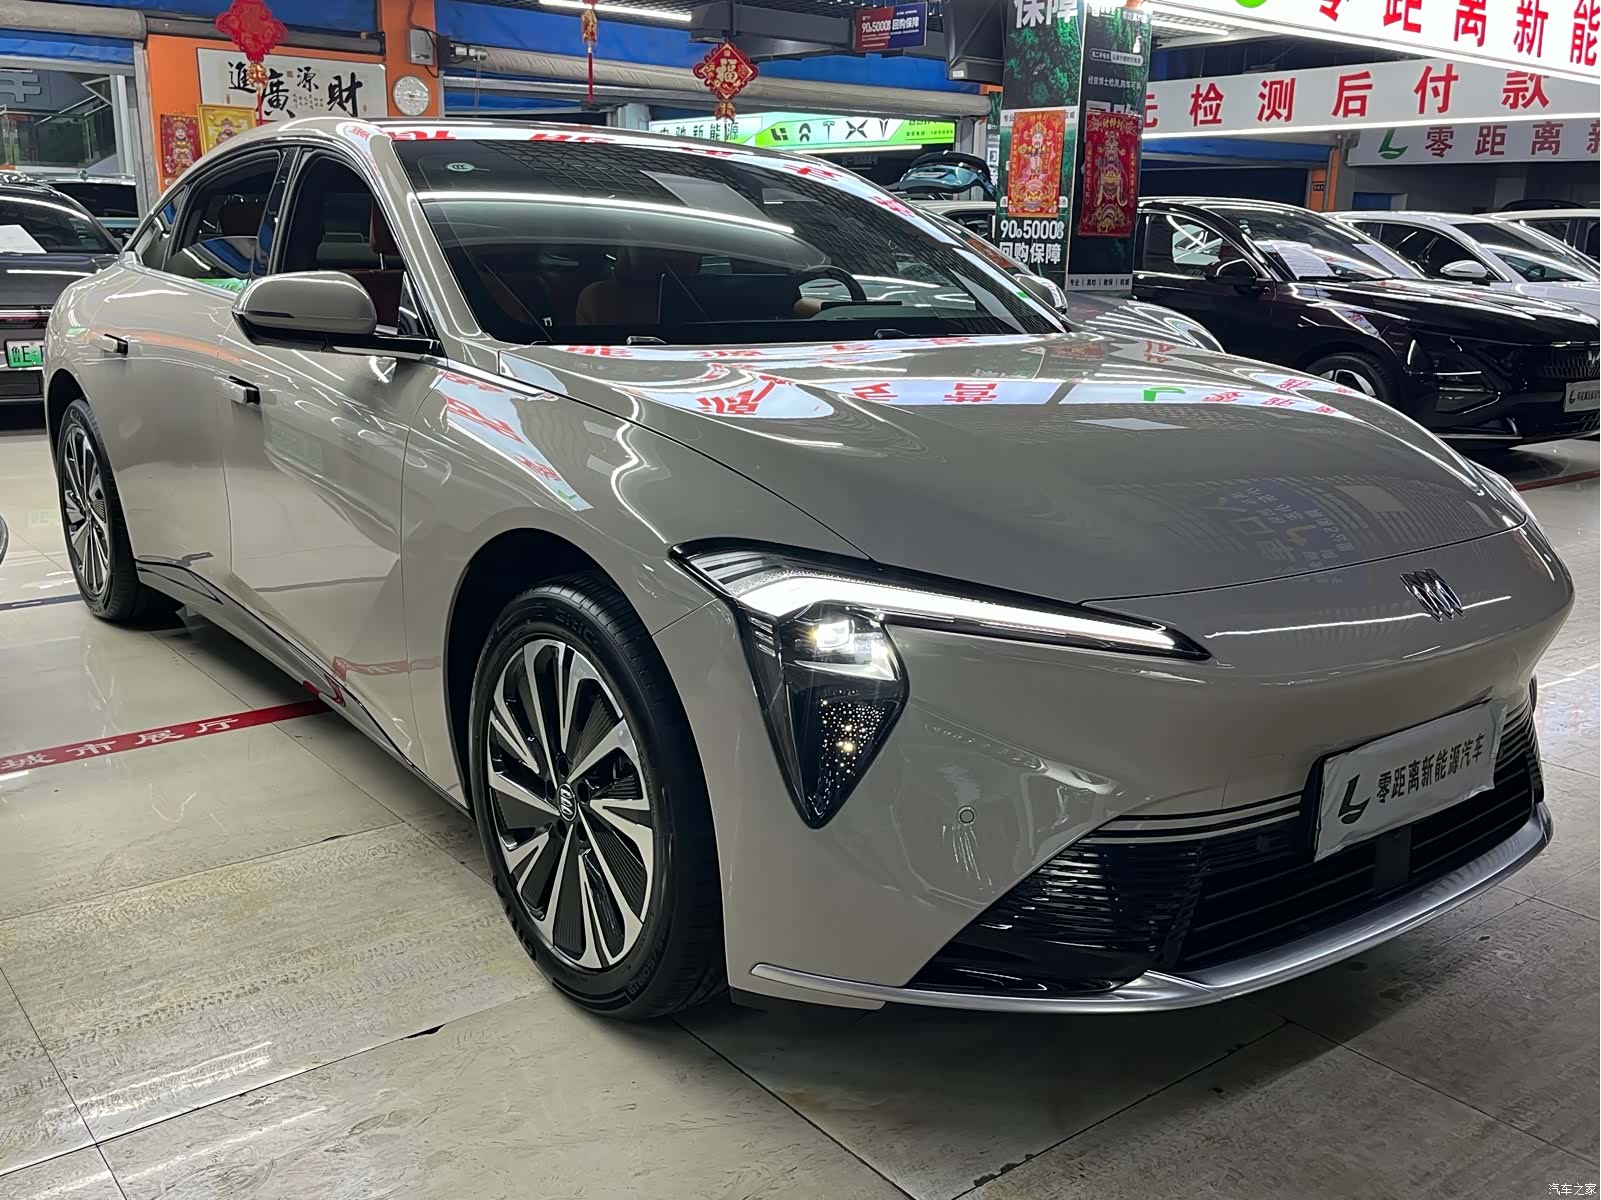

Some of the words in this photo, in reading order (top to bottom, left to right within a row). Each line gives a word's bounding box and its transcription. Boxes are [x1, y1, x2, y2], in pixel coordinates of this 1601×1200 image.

[1318, 0, 1600, 67] 距离新能
[715, 58, 738, 82] 福
[1000, 242, 1062, 265] 回购保障
[1376, 732, 1485, 804] 零距离新能源汽车
